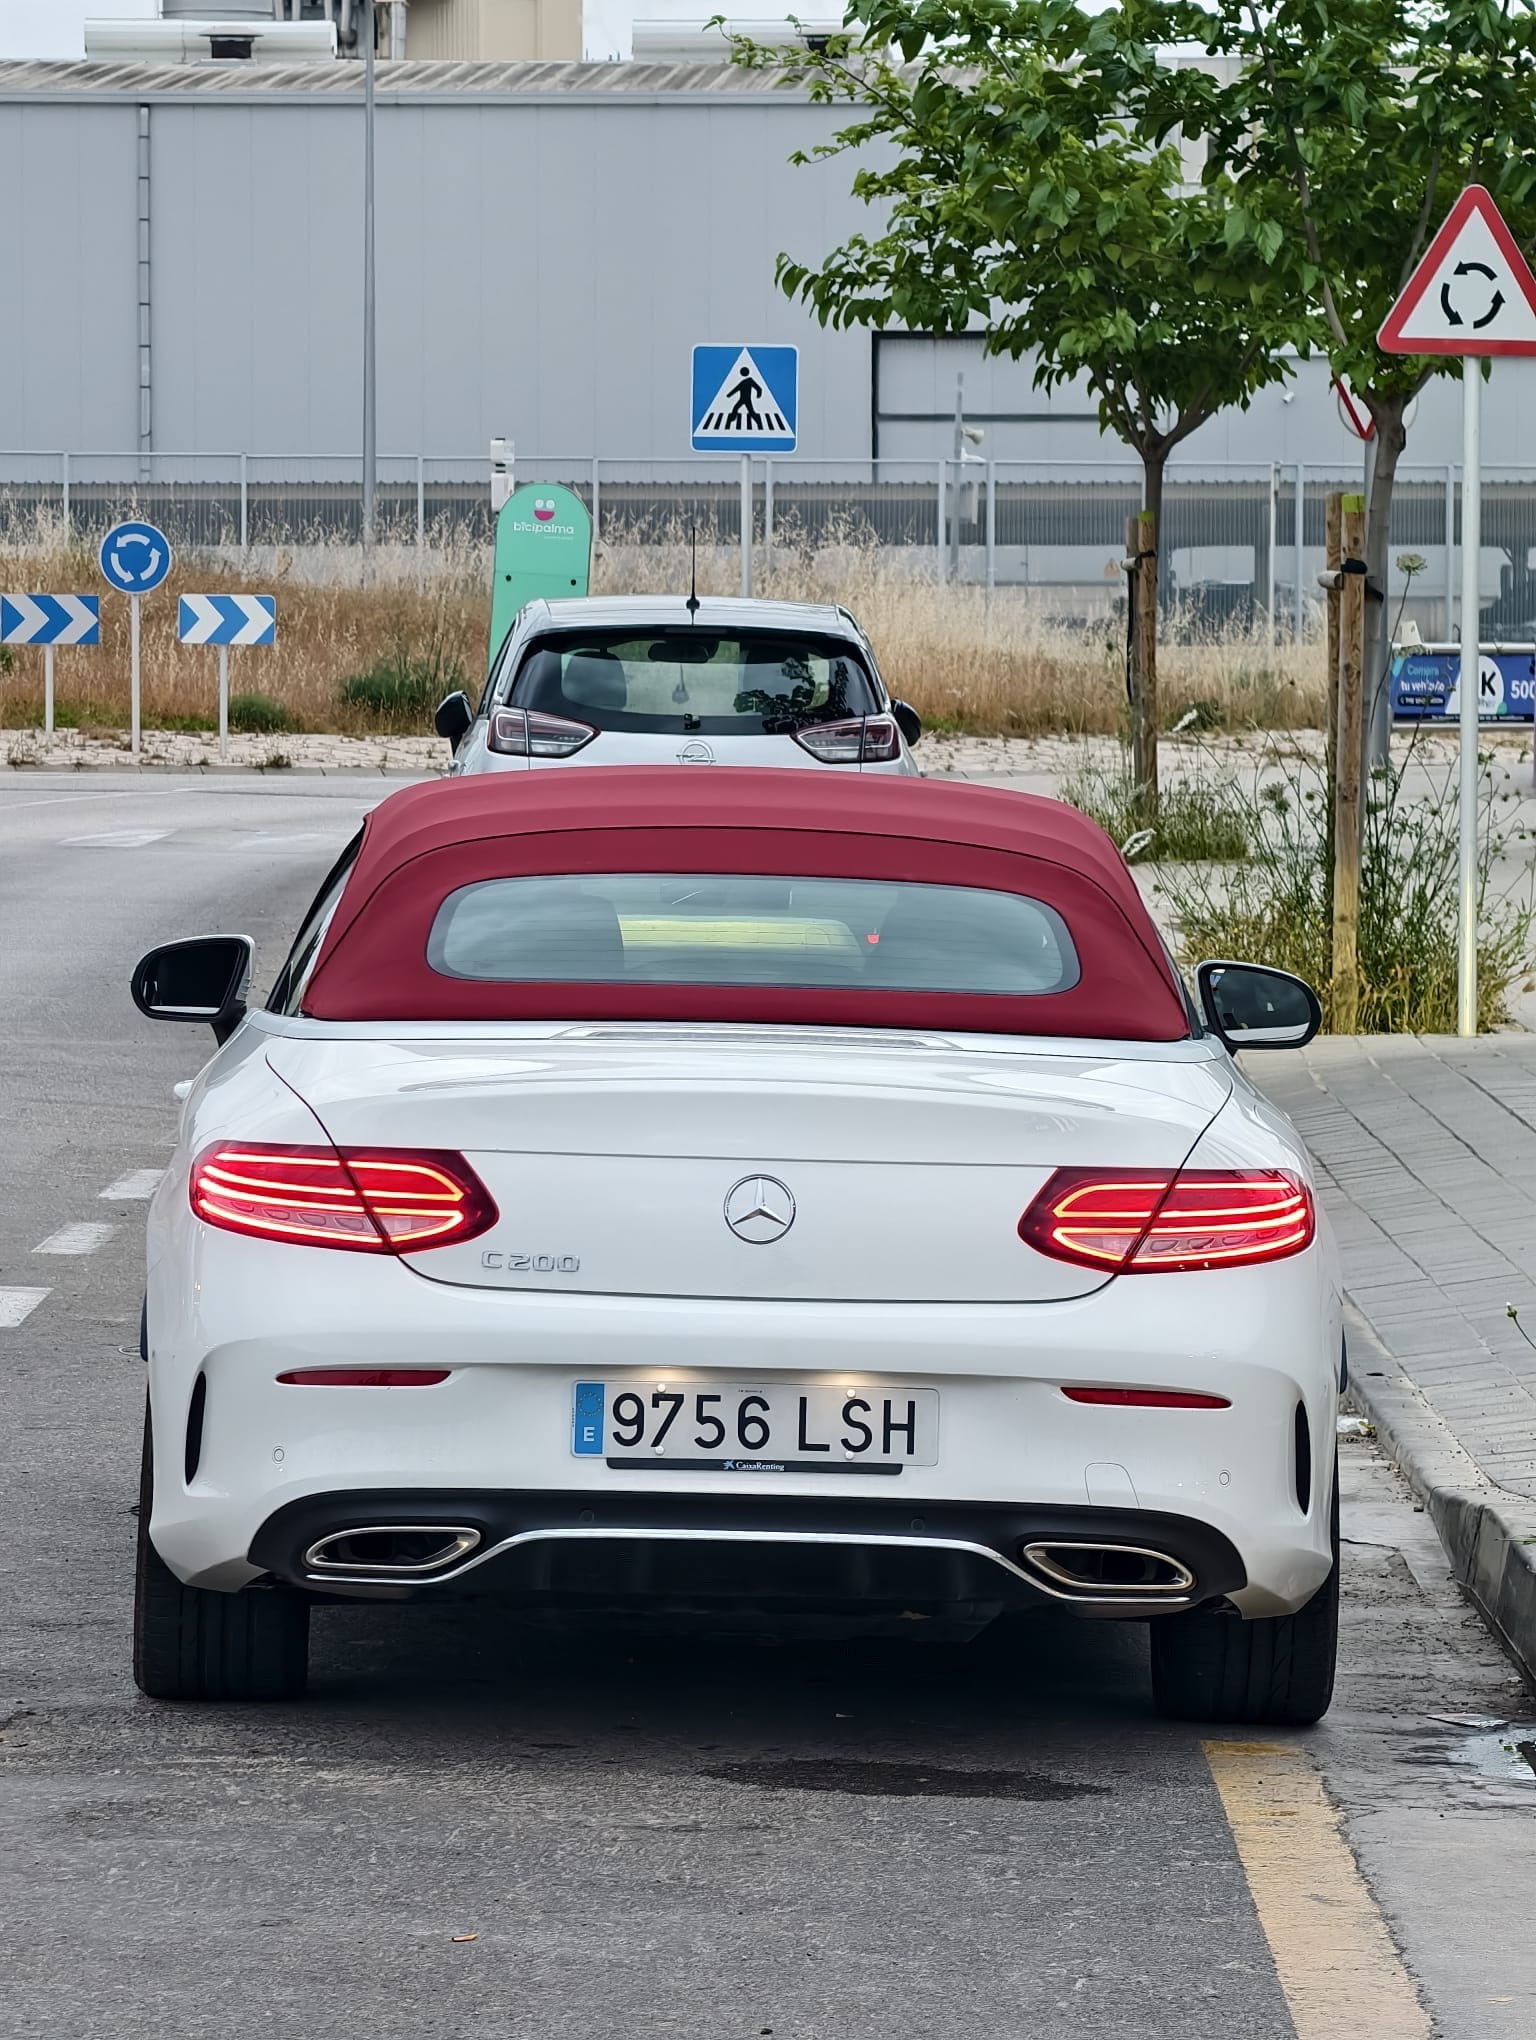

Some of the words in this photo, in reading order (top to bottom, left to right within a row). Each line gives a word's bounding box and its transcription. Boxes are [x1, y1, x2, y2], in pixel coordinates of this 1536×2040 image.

[583, 1426, 595, 1442] E
[612, 1392, 770, 1450] 9756
[798, 1396, 916, 1455] LSH
